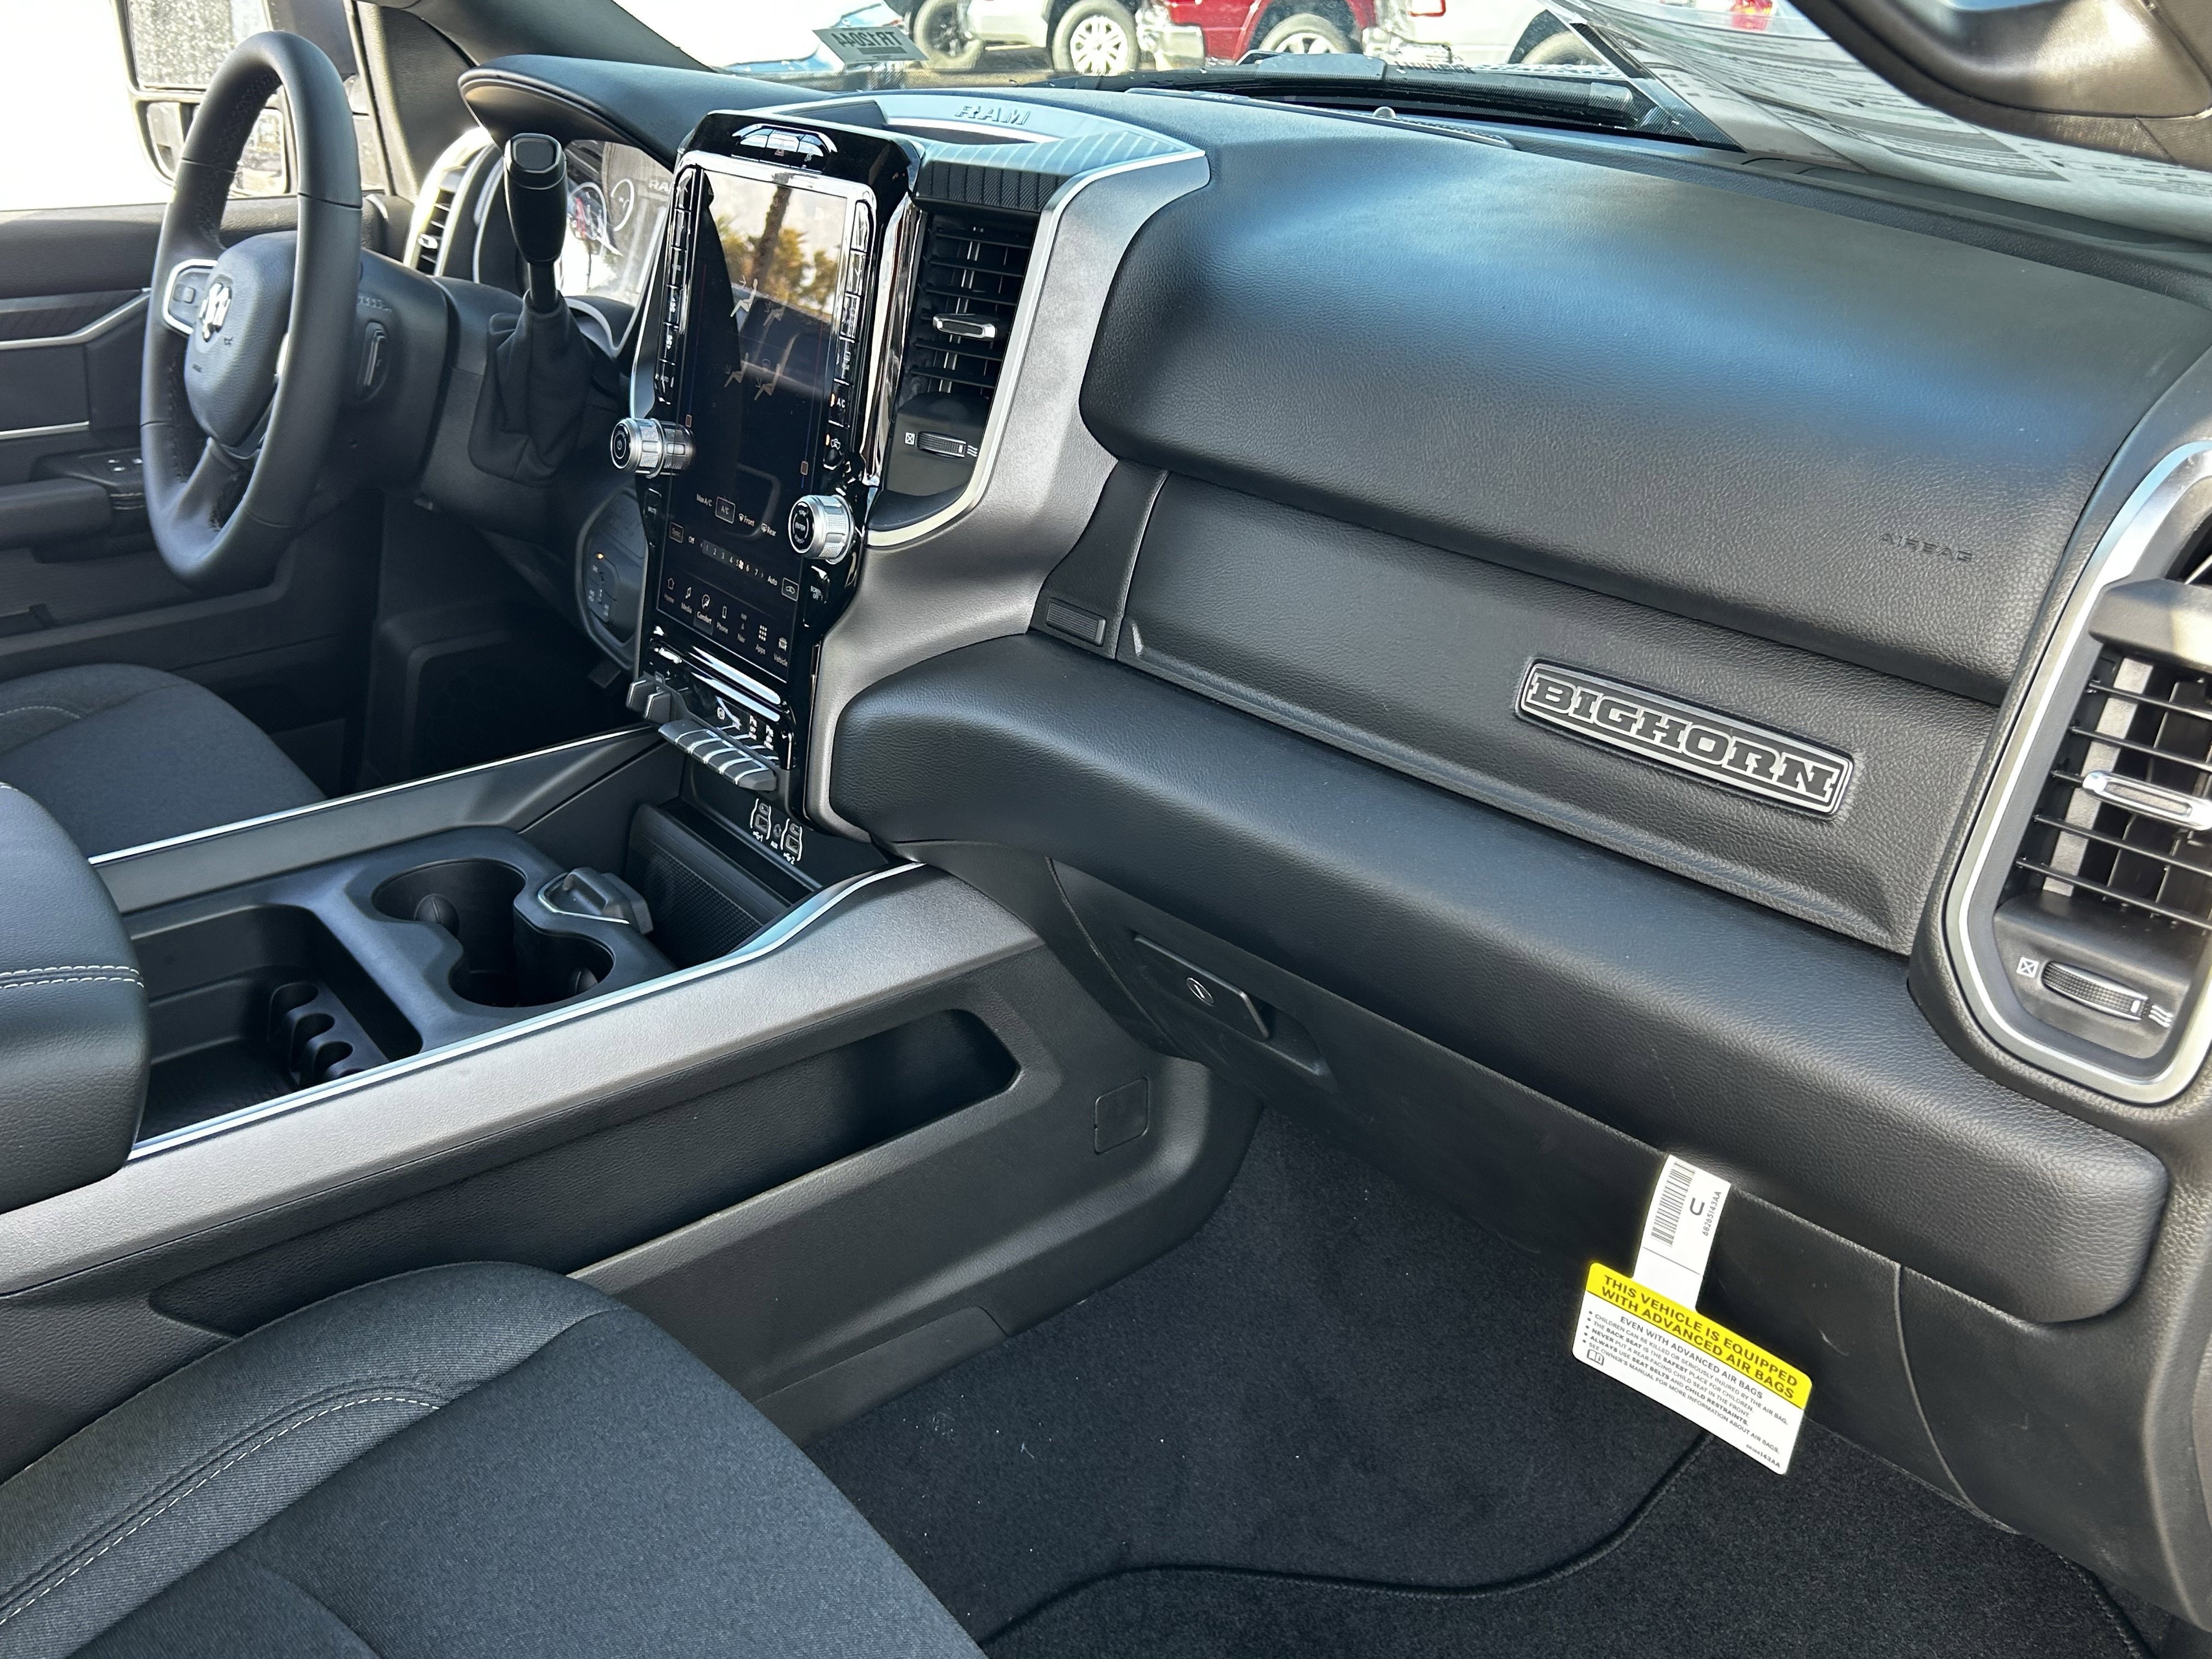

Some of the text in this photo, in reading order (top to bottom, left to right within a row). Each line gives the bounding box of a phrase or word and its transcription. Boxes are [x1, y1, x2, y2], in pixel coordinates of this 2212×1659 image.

[955, 105, 1031, 126] RAM
[721, 505, 730, 515] A/C
[744, 515, 755, 527] Front
[768, 575, 778, 586] Auto
[681, 602, 692, 614] Media
[697, 611, 712, 625] Comfort
[716, 622, 729, 634] Phone
[737, 633, 746, 643] Nav
[755, 644, 766, 654] Apps
[774, 653, 788, 667] Vehicle
[1526, 672, 1841, 802] BIGHORN
[1690, 1197, 1705, 1216] U
[1702, 1191, 1722, 1236] 68265143AA
[1604, 1274, 1797, 1386] THIS VEHICLE IS EQUIPPED
[1602, 1286, 1793, 1398] WITH ADVANCED AIR BAGS
[1592, 1328, 1613, 1342] NEVER
[1615, 1340, 1627, 1348] PUT
[1673, 1370, 1691, 1383] CHILD
[1692, 1381, 1707, 1392] SEAT
[1717, 1394, 1728, 1404] THE
[1594, 1321, 1605, 1330] THE
[1606, 1327, 1624, 1340] BACK
[1625, 1338, 1642, 1348] SEAT
[1650, 1350, 1661, 1359] THE
[1663, 1357, 1688, 1373] SAFEST
[1689, 1370, 1708, 1384] PLACE
[1709, 1382, 1721, 1392] FOR
[1594, 1314, 1624, 1332] CHILDREN
[1626, 1329, 1639, 1339] CAN
[1649, 1341, 1669, 1355] KILLED
[1681, 1358, 1713, 1379] SERIOUSLY
[1714, 1377, 1739, 1395] INJURED
[1750, 1397, 1762, 1408] THE
[1762, 1406, 1773, 1415] AIR
[1620, 1316, 1762, 1398] EVEN WITH ADVANCED AIR BAGS
[1590, 1335, 1617, 1352] ALWAYS
[1618, 1350, 1630, 1359] USE
[1632, 1357, 1649, 1368] SEAT
[1649, 1365, 1669, 1379] BELTS
[1670, 1378, 1683, 1387] AND
[1685, 1385, 1706, 1400] CHILD
[1589, 1342, 1599, 1351] SEE
[1629, 1363, 1654, 1380] MANUAL
[1655, 1377, 1668, 1387] FOR
[1668, 1384, 1686, 1397] MORE
[1687, 1395, 1728, 1421] INFORMATION
[1729, 1420, 1750, 1434] ABOUT
[1750, 1432, 1761, 1442] AIR
